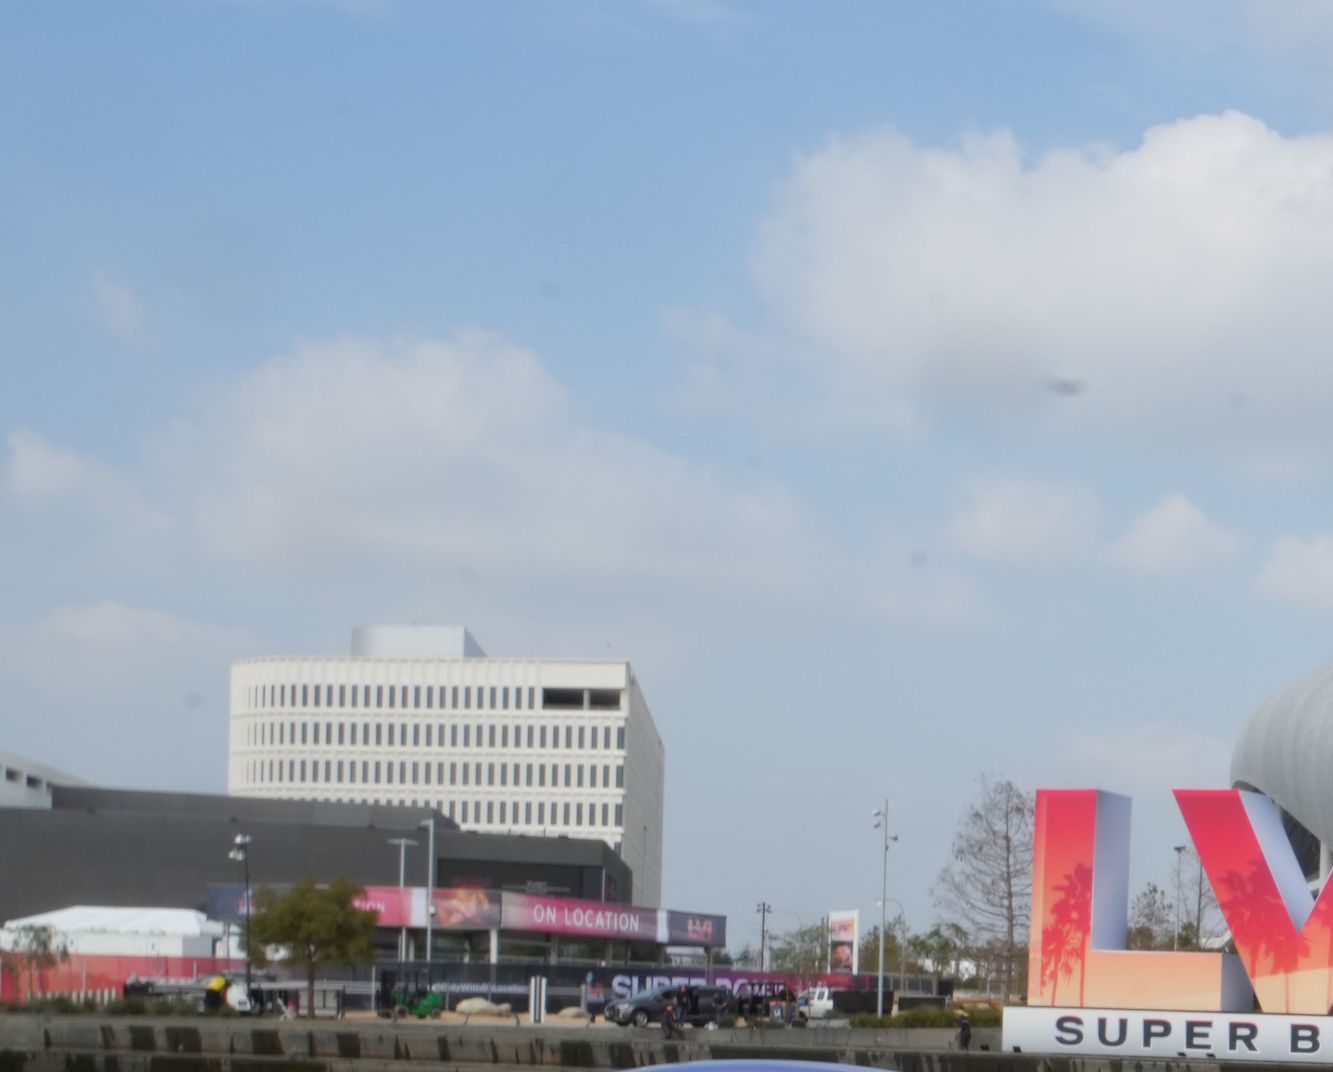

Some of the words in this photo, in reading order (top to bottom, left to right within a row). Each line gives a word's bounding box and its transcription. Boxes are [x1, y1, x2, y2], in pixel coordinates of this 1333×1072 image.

[533, 904, 557, 928] ON
[564, 906, 640, 933] LOCATION
[612, 975, 708, 1001] SUP
[1054, 1015, 1259, 1052] SUPER
